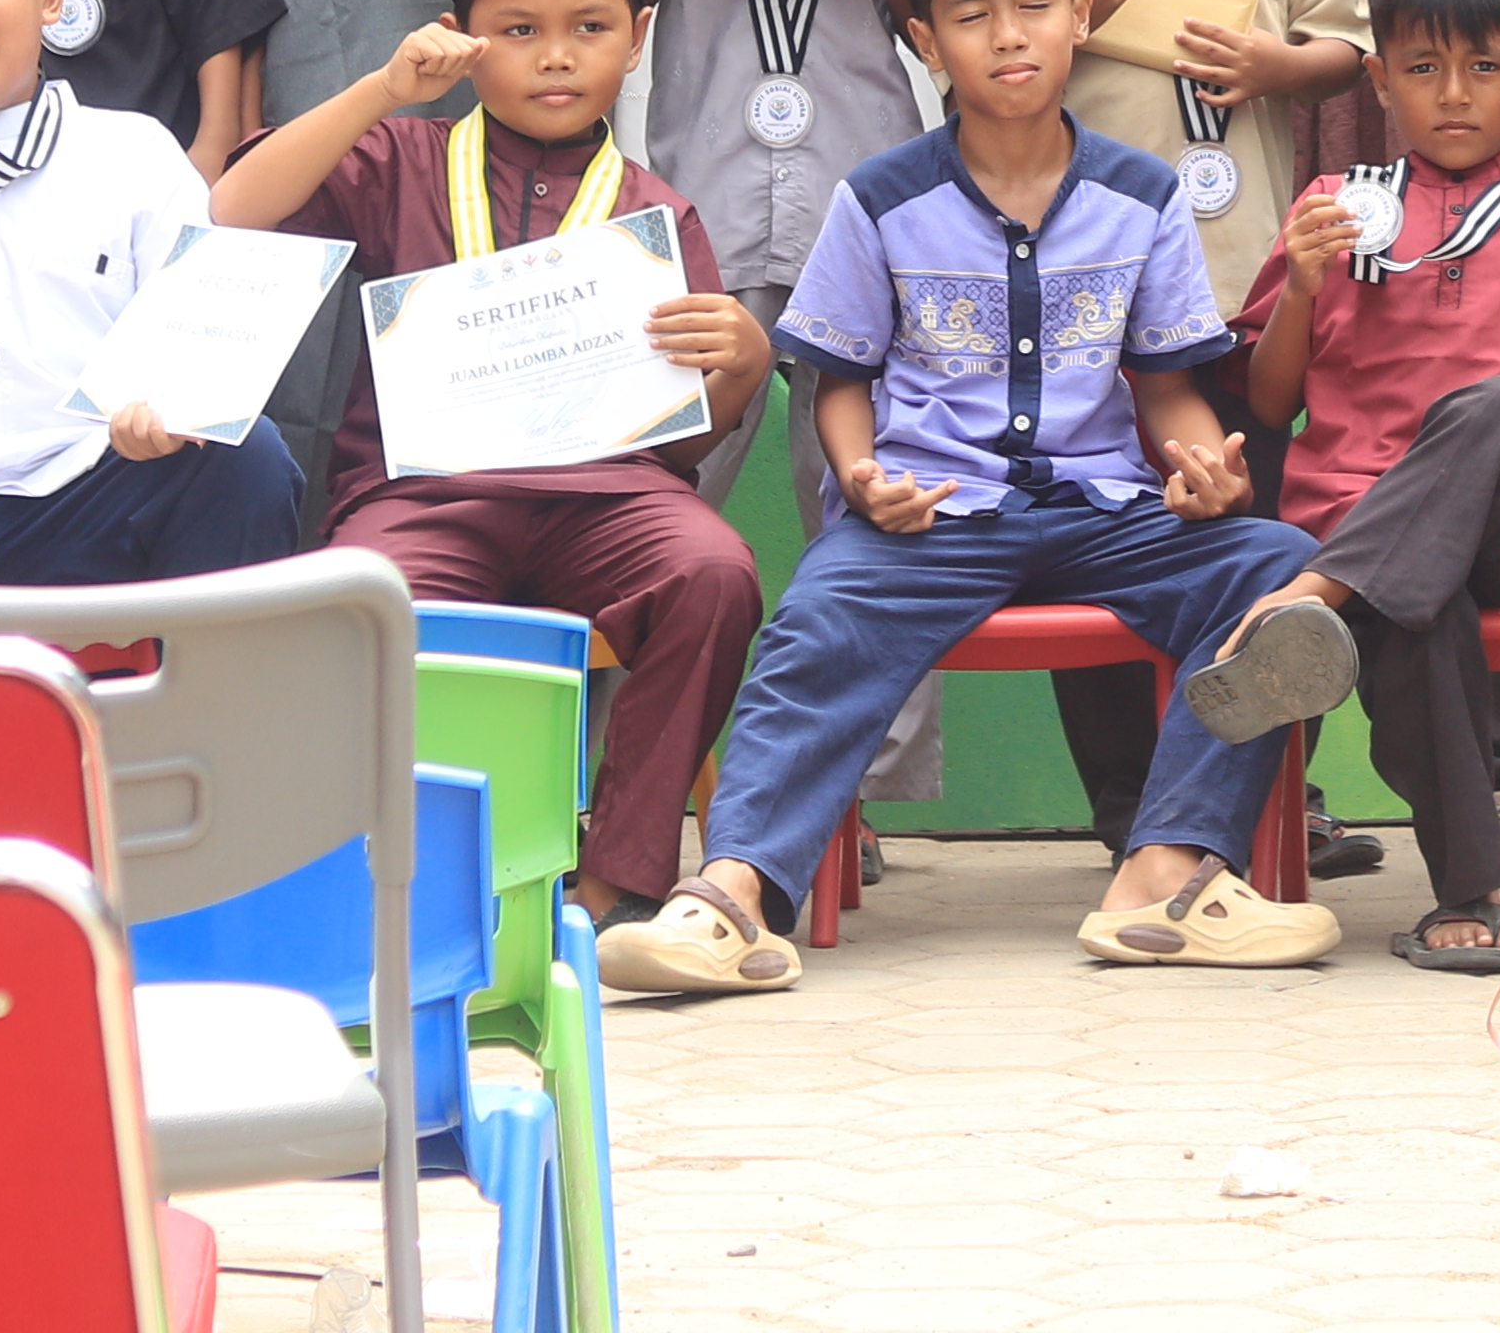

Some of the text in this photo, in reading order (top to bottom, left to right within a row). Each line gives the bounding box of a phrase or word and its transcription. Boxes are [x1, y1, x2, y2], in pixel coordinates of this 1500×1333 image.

[457, 280, 599, 331] SERTIFIKAT
[448, 362, 500, 385] JUARA
[514, 346, 568, 371] LOMBA
[573, 329, 626, 354] ADZAN
